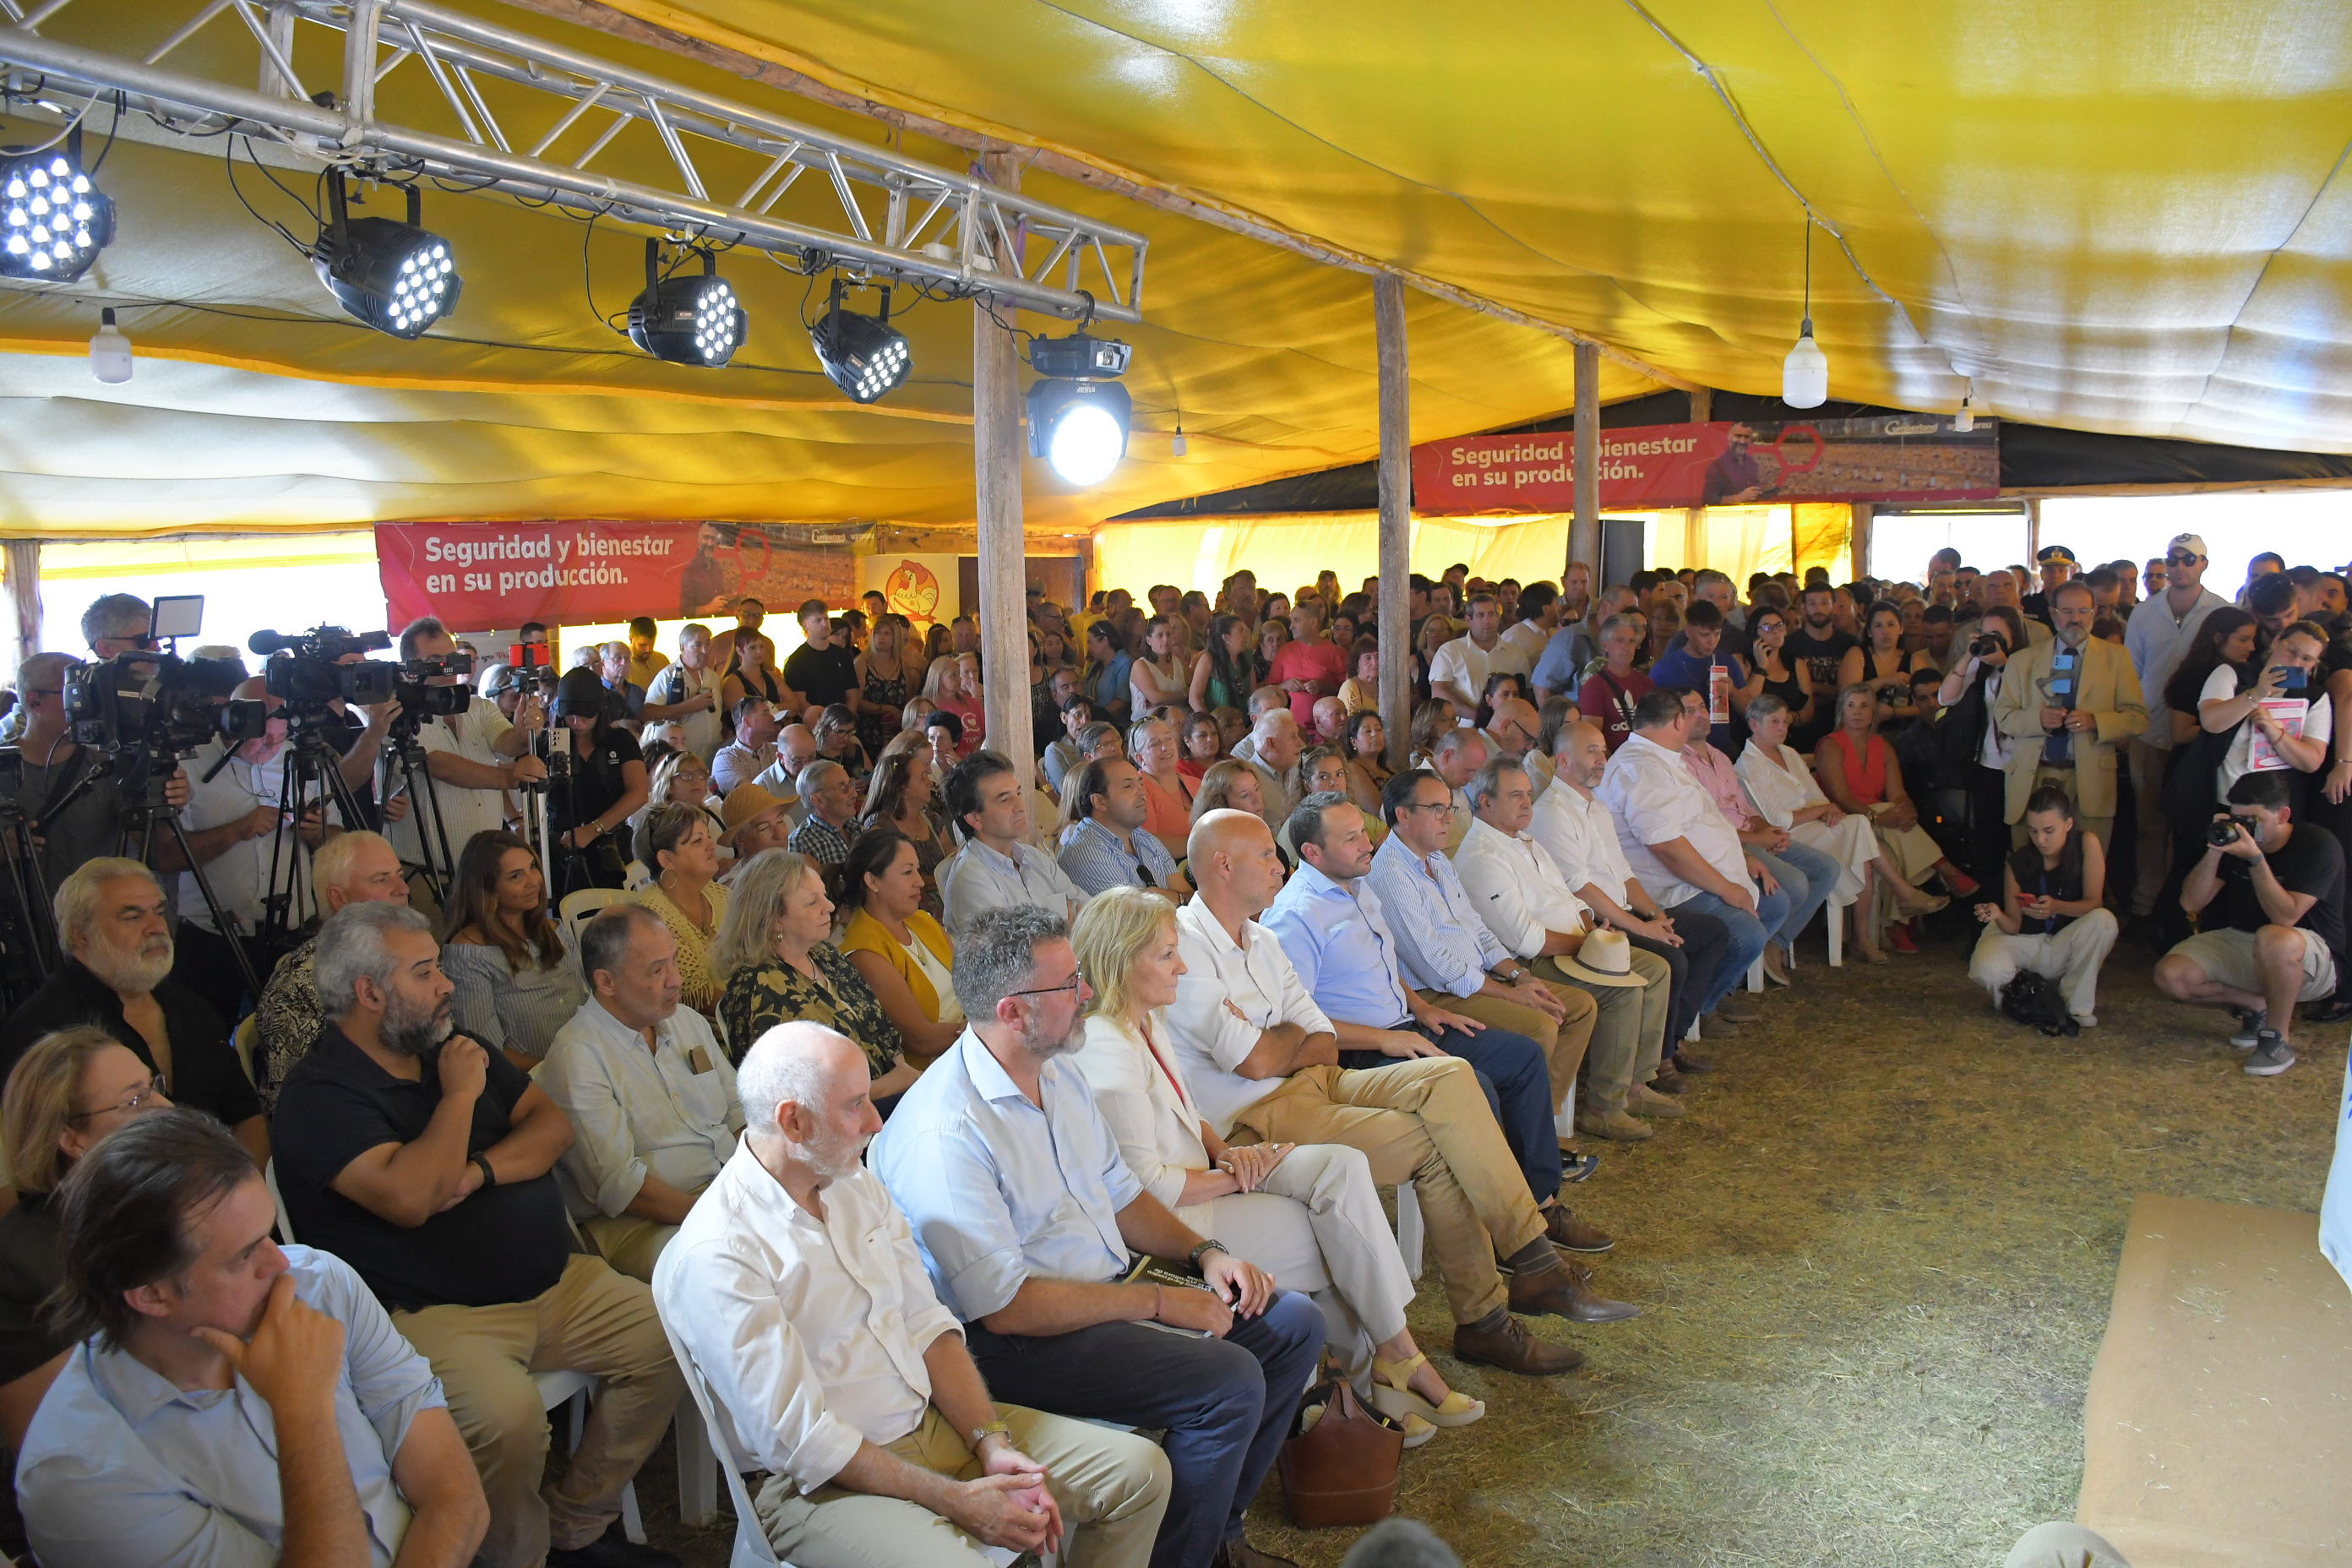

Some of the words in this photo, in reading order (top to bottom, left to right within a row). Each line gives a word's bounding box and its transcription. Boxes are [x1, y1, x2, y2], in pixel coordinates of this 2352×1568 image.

[1451, 441, 1563, 469] Seguridad
[1452, 472, 1477, 487] en
[1484, 471, 1507, 486] su
[1515, 463, 1644, 489] produión.
[426, 533, 551, 568] Seguridad
[557, 540, 570, 564] y
[576, 532, 673, 556] bienestar
[426, 574, 455, 594] en
[464, 572, 492, 591] su
[499, 560, 629, 596] producción.
